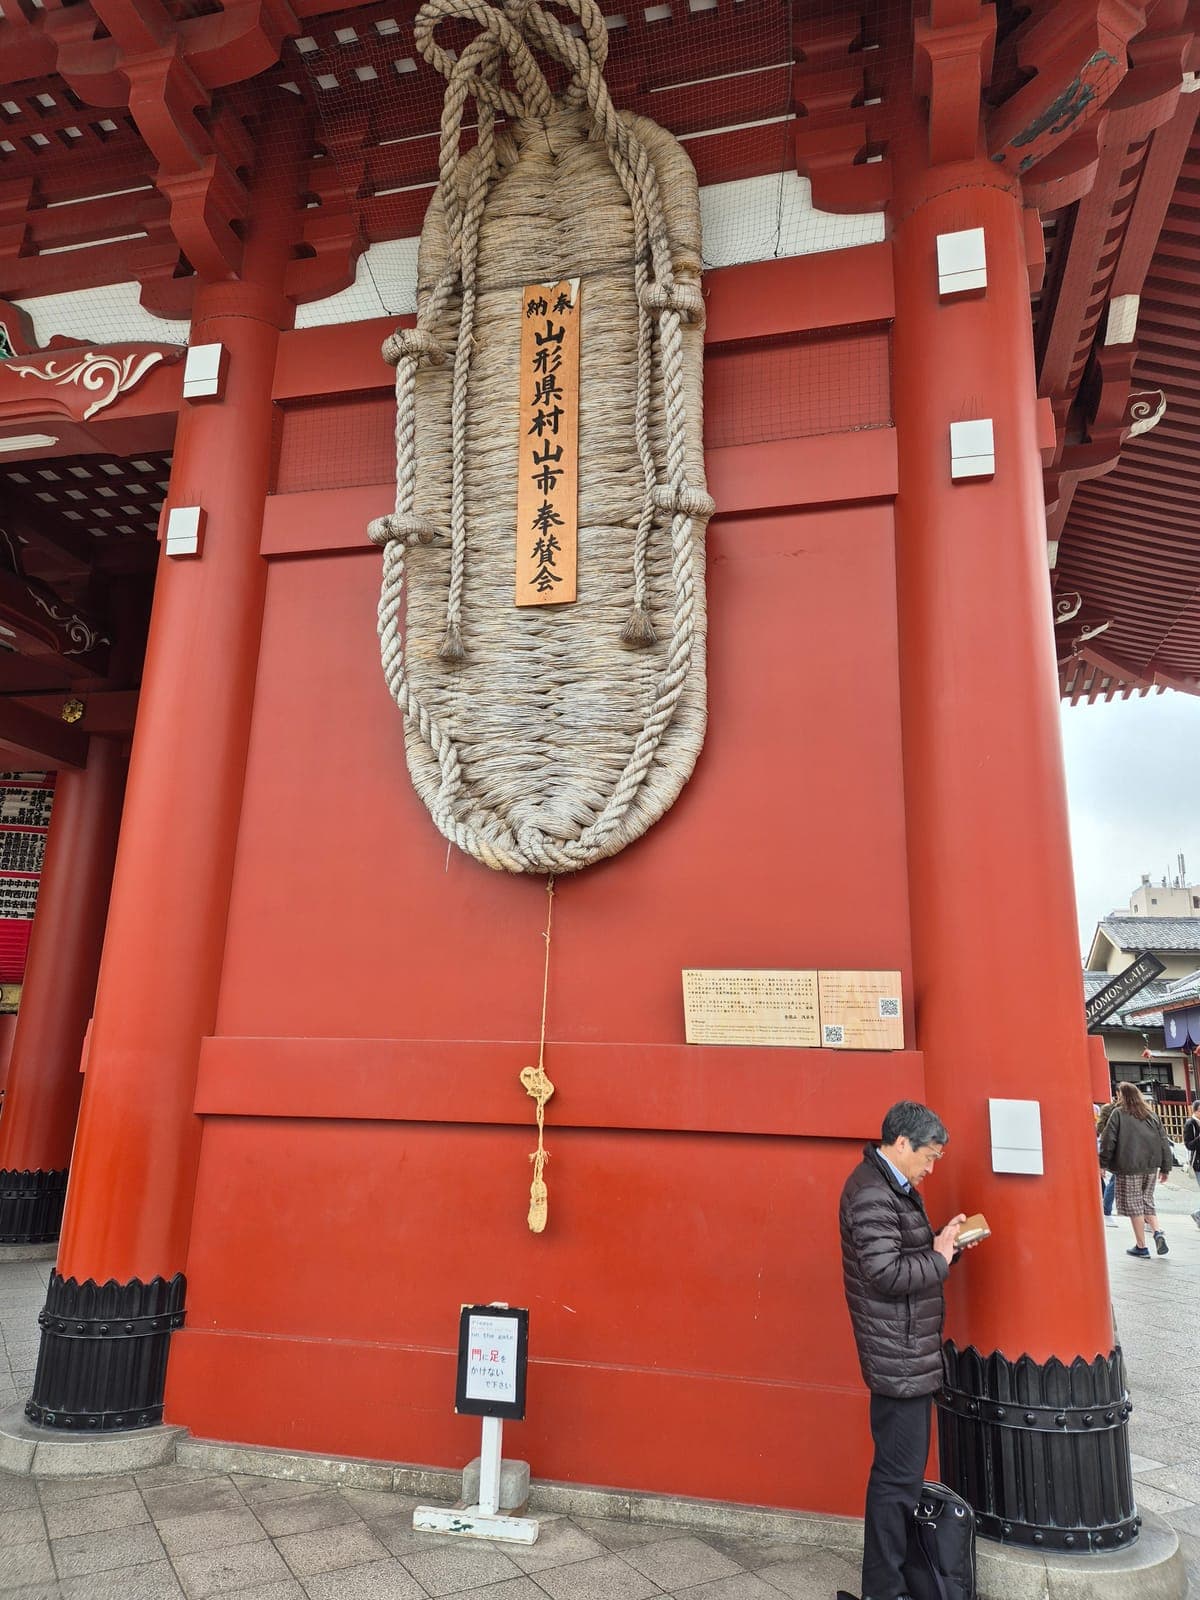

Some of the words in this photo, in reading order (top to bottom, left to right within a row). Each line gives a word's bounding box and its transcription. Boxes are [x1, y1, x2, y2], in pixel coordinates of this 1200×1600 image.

[527, 318, 566, 593] 山形県村山市奉賛会
[1124, 962, 1147, 984] GATE
[472, 1348, 506, 1363] 門に足を
[471, 1367, 504, 1378] かけない
